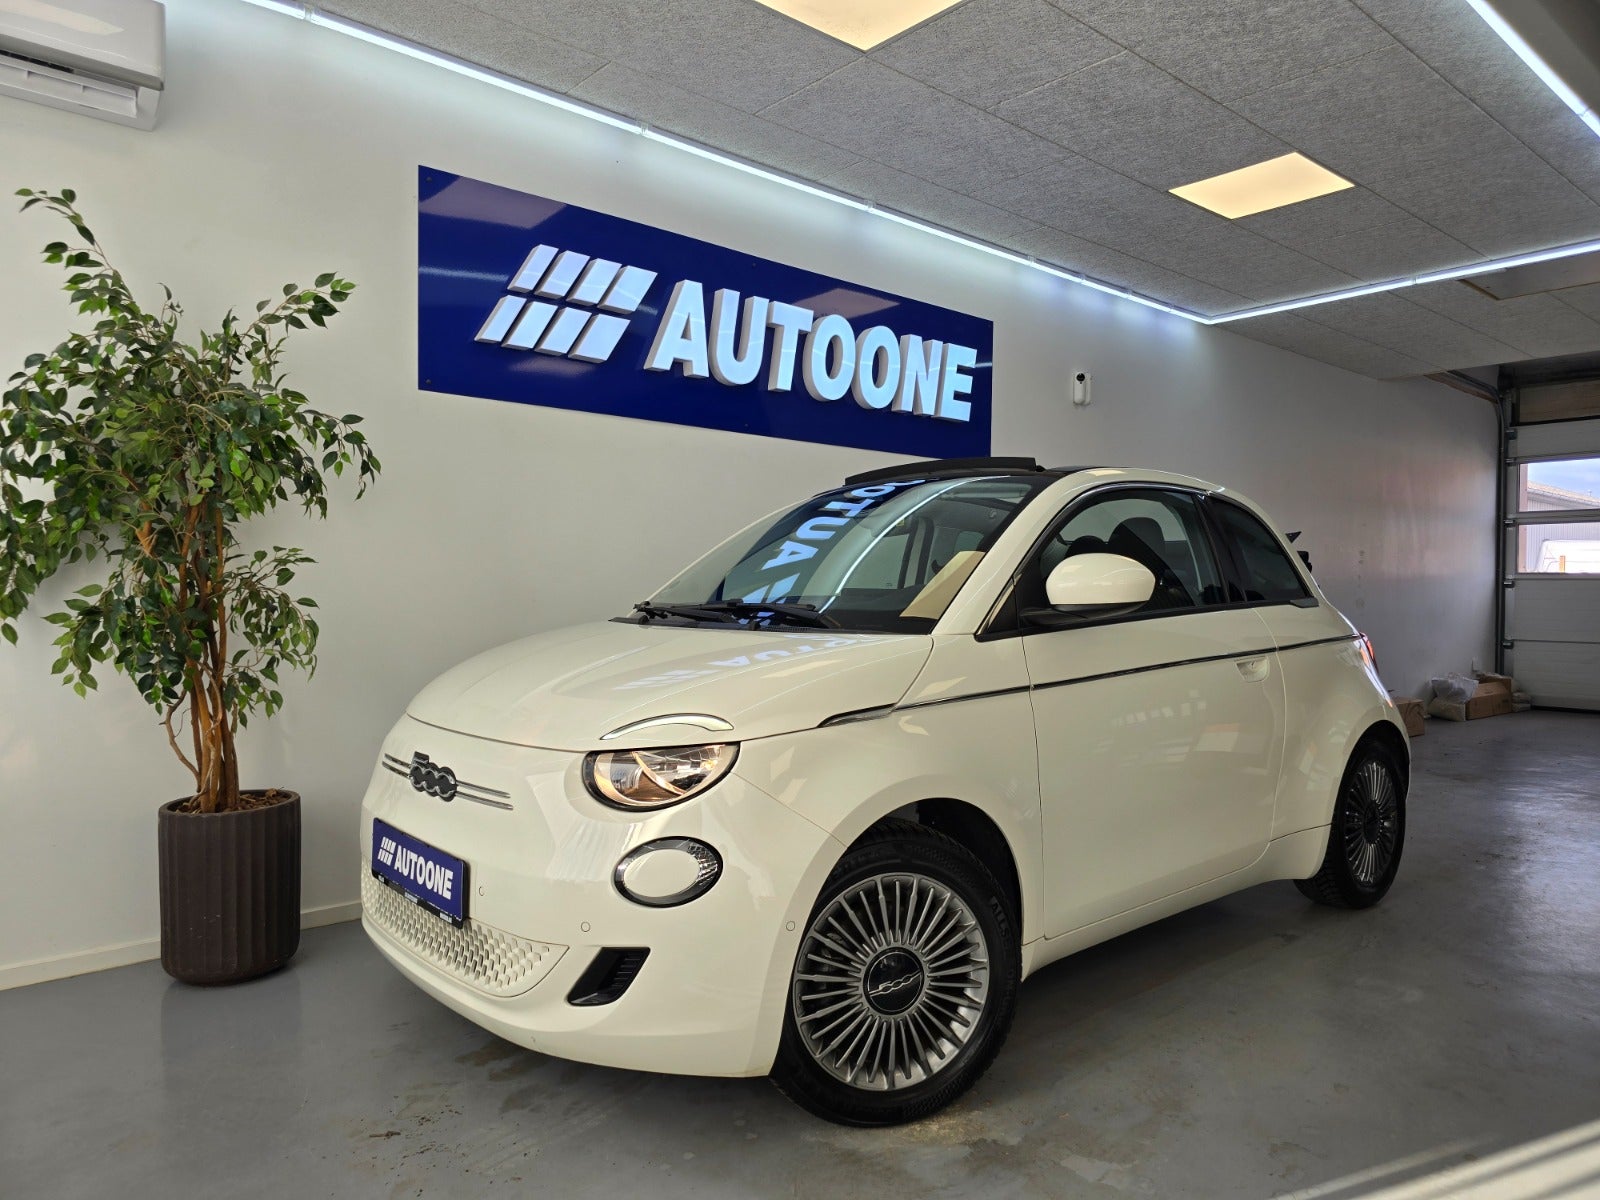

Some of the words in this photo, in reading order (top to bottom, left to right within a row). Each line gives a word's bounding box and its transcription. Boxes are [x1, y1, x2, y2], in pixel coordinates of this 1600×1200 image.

[643, 279, 978, 423] AUTOONE
[410, 750, 458, 803] 500
[394, 845, 454, 901] AUTOONE
